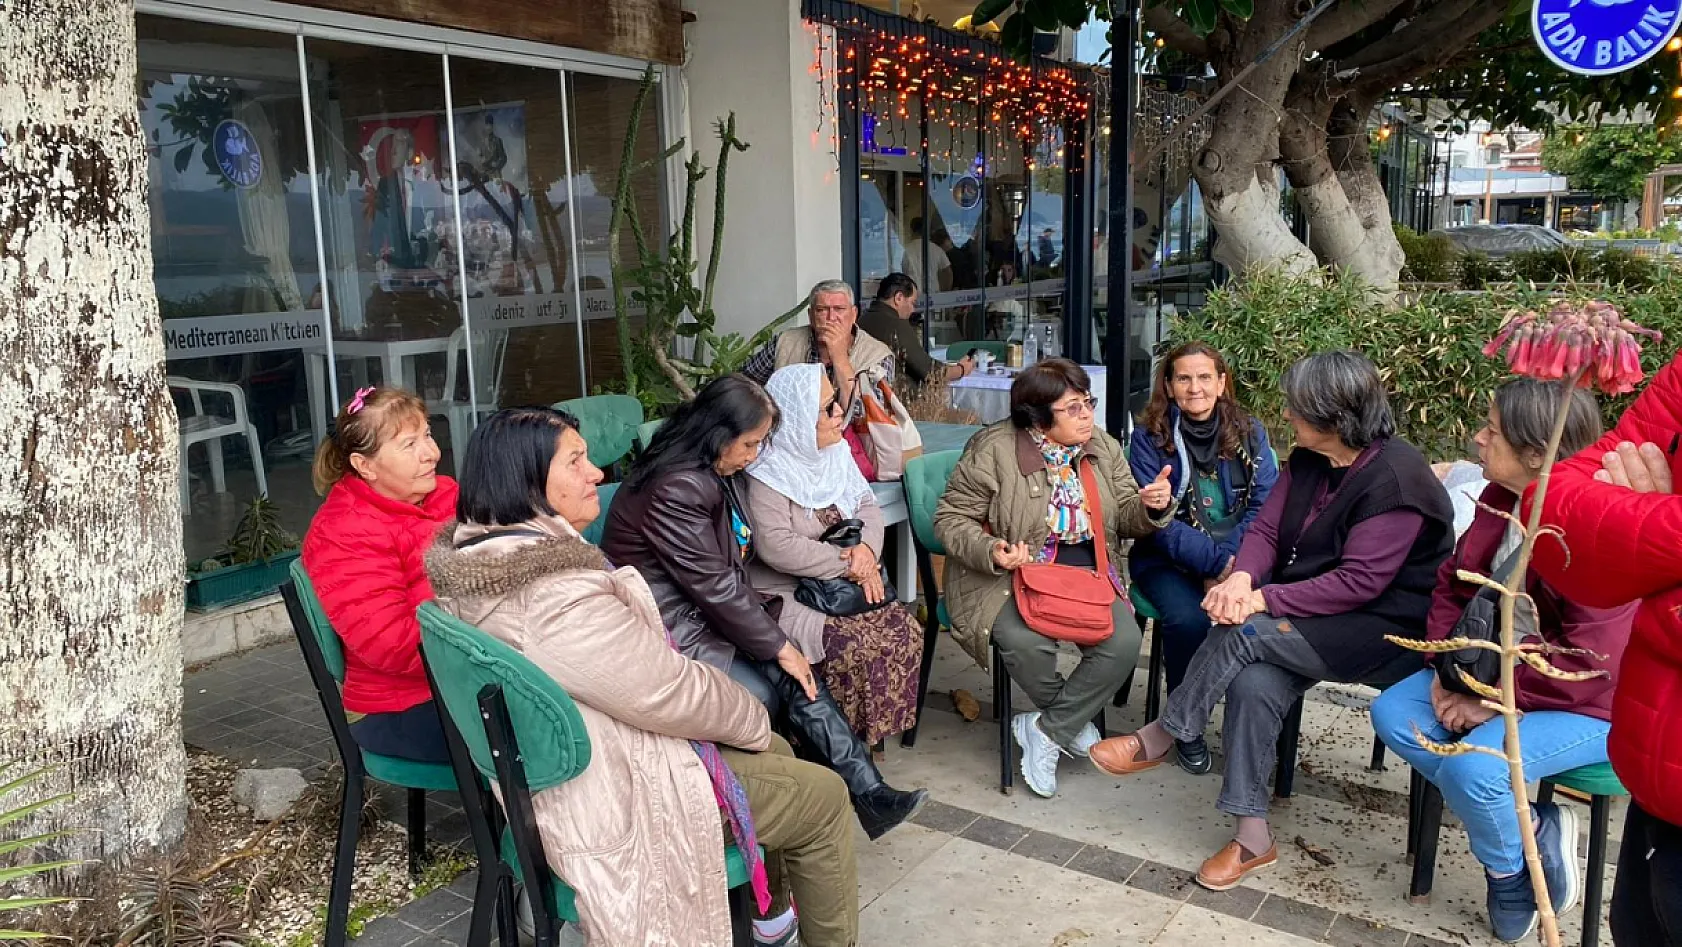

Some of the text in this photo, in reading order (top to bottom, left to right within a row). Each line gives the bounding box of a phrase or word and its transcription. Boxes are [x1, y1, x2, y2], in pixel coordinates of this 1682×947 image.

[1542, 4, 1676, 66] ADA BALIK
[165, 327, 268, 350] Mediterranean
